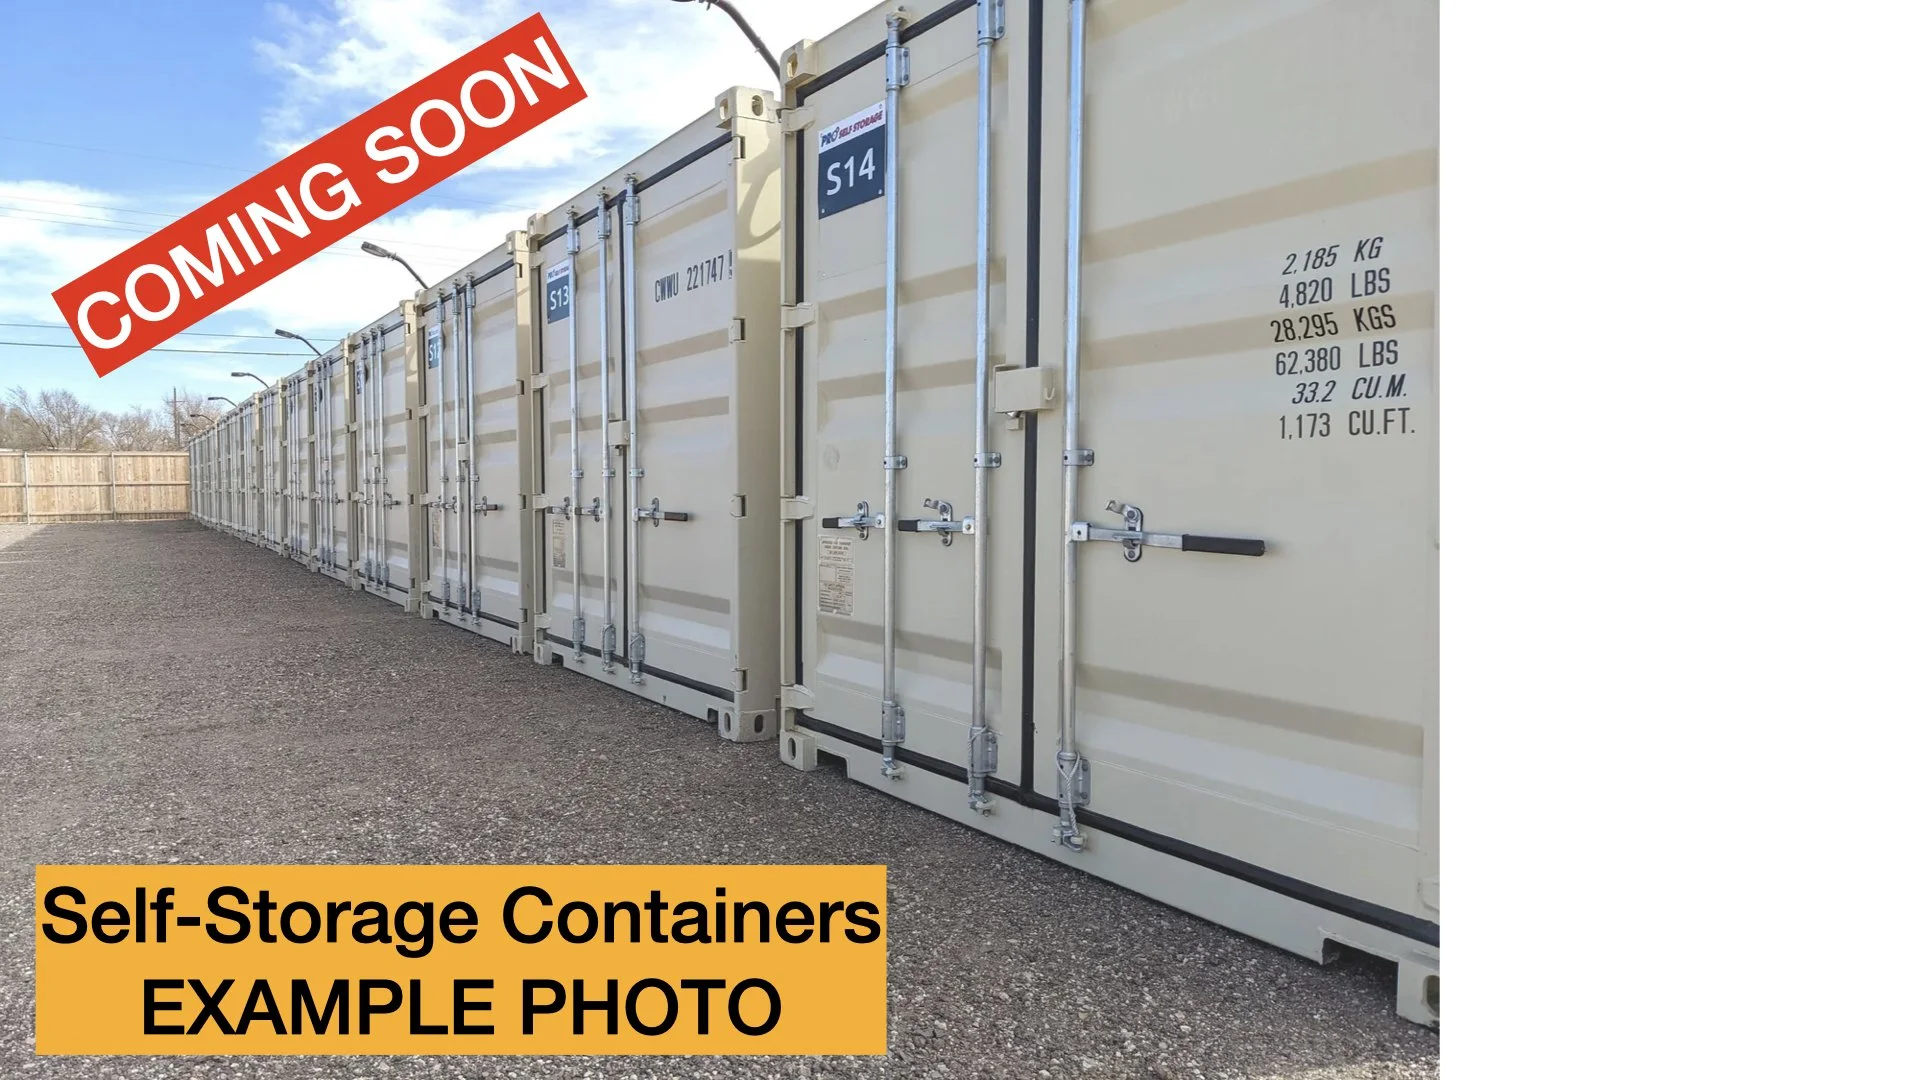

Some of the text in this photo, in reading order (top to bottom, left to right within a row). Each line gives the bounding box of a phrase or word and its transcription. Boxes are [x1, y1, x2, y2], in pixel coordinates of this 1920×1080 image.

[839, 126, 853, 139] SELF
[852, 110, 883, 133] STORAGE
[826, 147, 876, 196] S14
[1282, 236, 1384, 275] 2,185 KG
[655, 273, 679, 303] CWWU
[686, 254, 724, 292] 221747
[1279, 267, 1391, 309] 4,820 LBS
[550, 285, 569, 311] S13
[1270, 304, 1396, 343] 28,295 KGS
[1275, 339, 1399, 376] 62,380 LBS
[1291, 373, 1407, 404] 33.2 CU.M.
[1279, 407, 1416, 440] 1,173 CU.FT.
